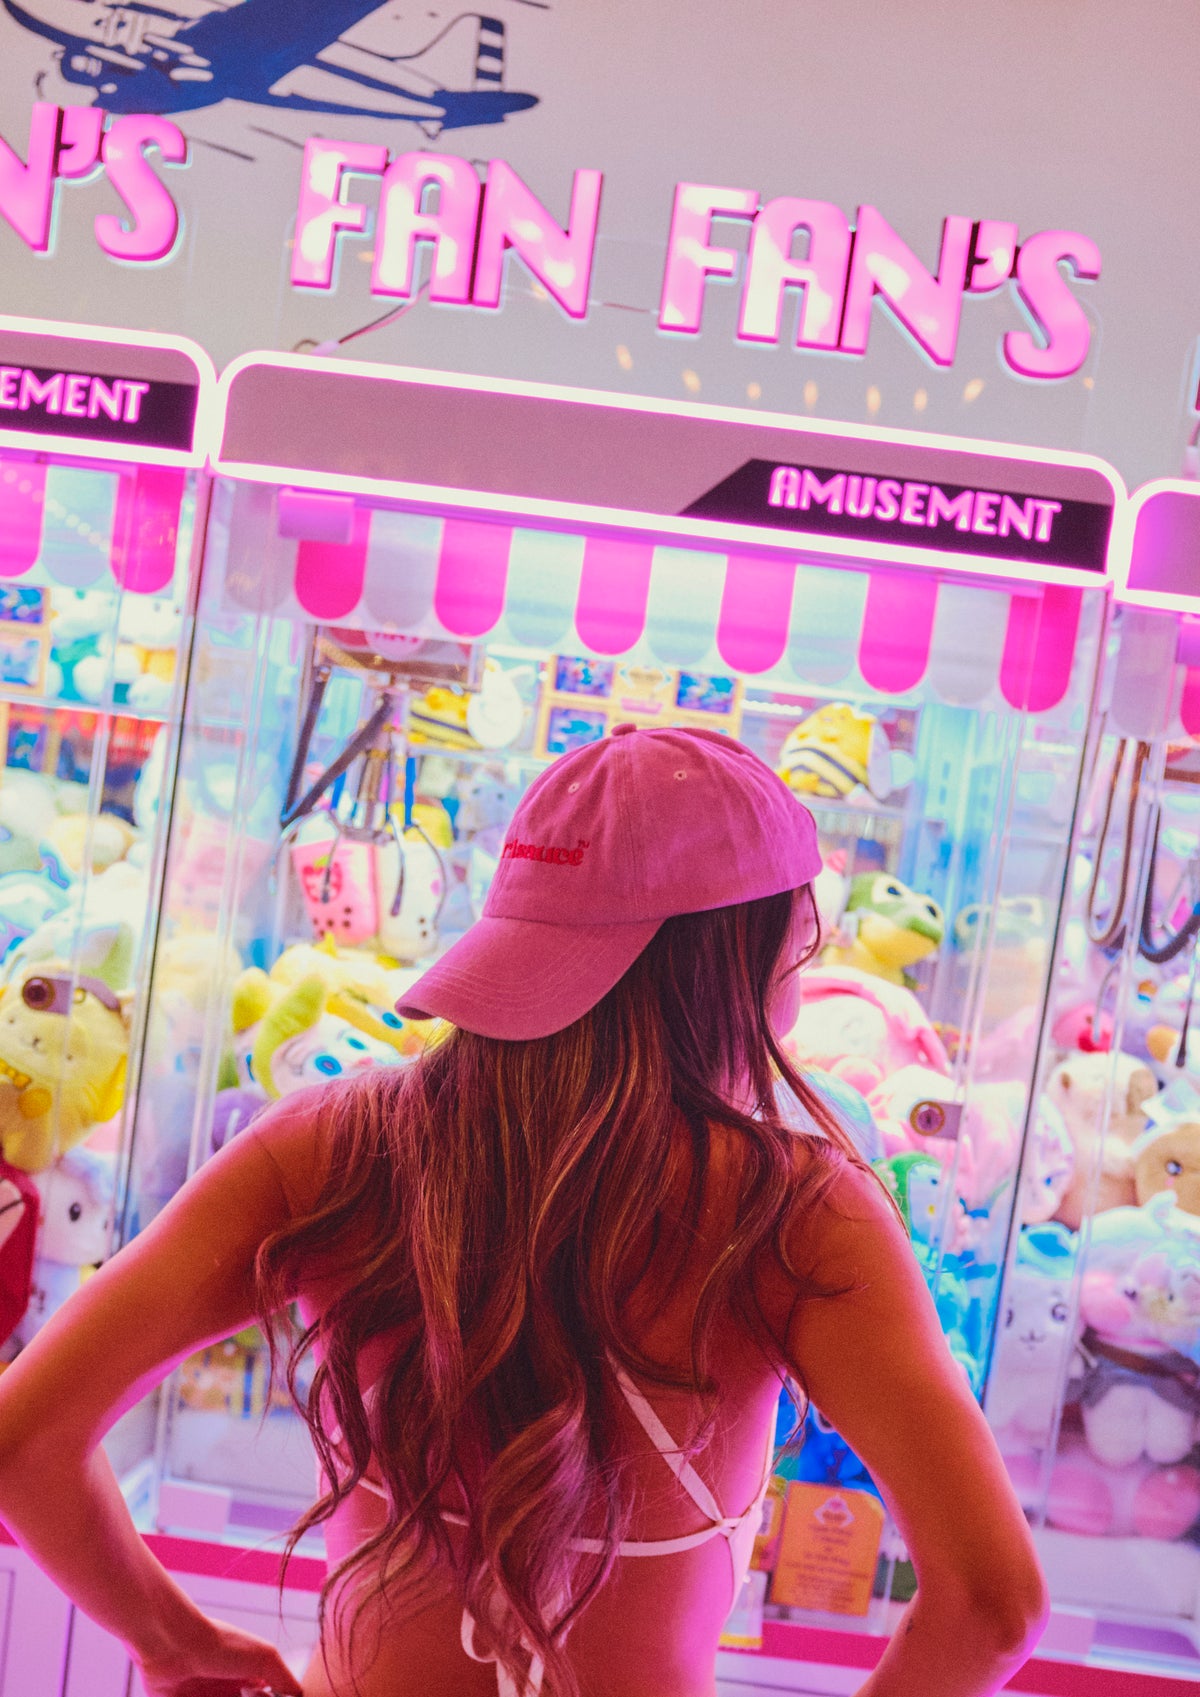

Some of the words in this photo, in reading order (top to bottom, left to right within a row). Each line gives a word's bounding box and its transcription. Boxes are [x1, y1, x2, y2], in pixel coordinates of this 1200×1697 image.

[291, 137, 604, 320] FAN
[658, 182, 1101, 380] FAN'S
[0, 366, 150, 423] EMENT
[768, 466, 1062, 542] AMUSEMENT
